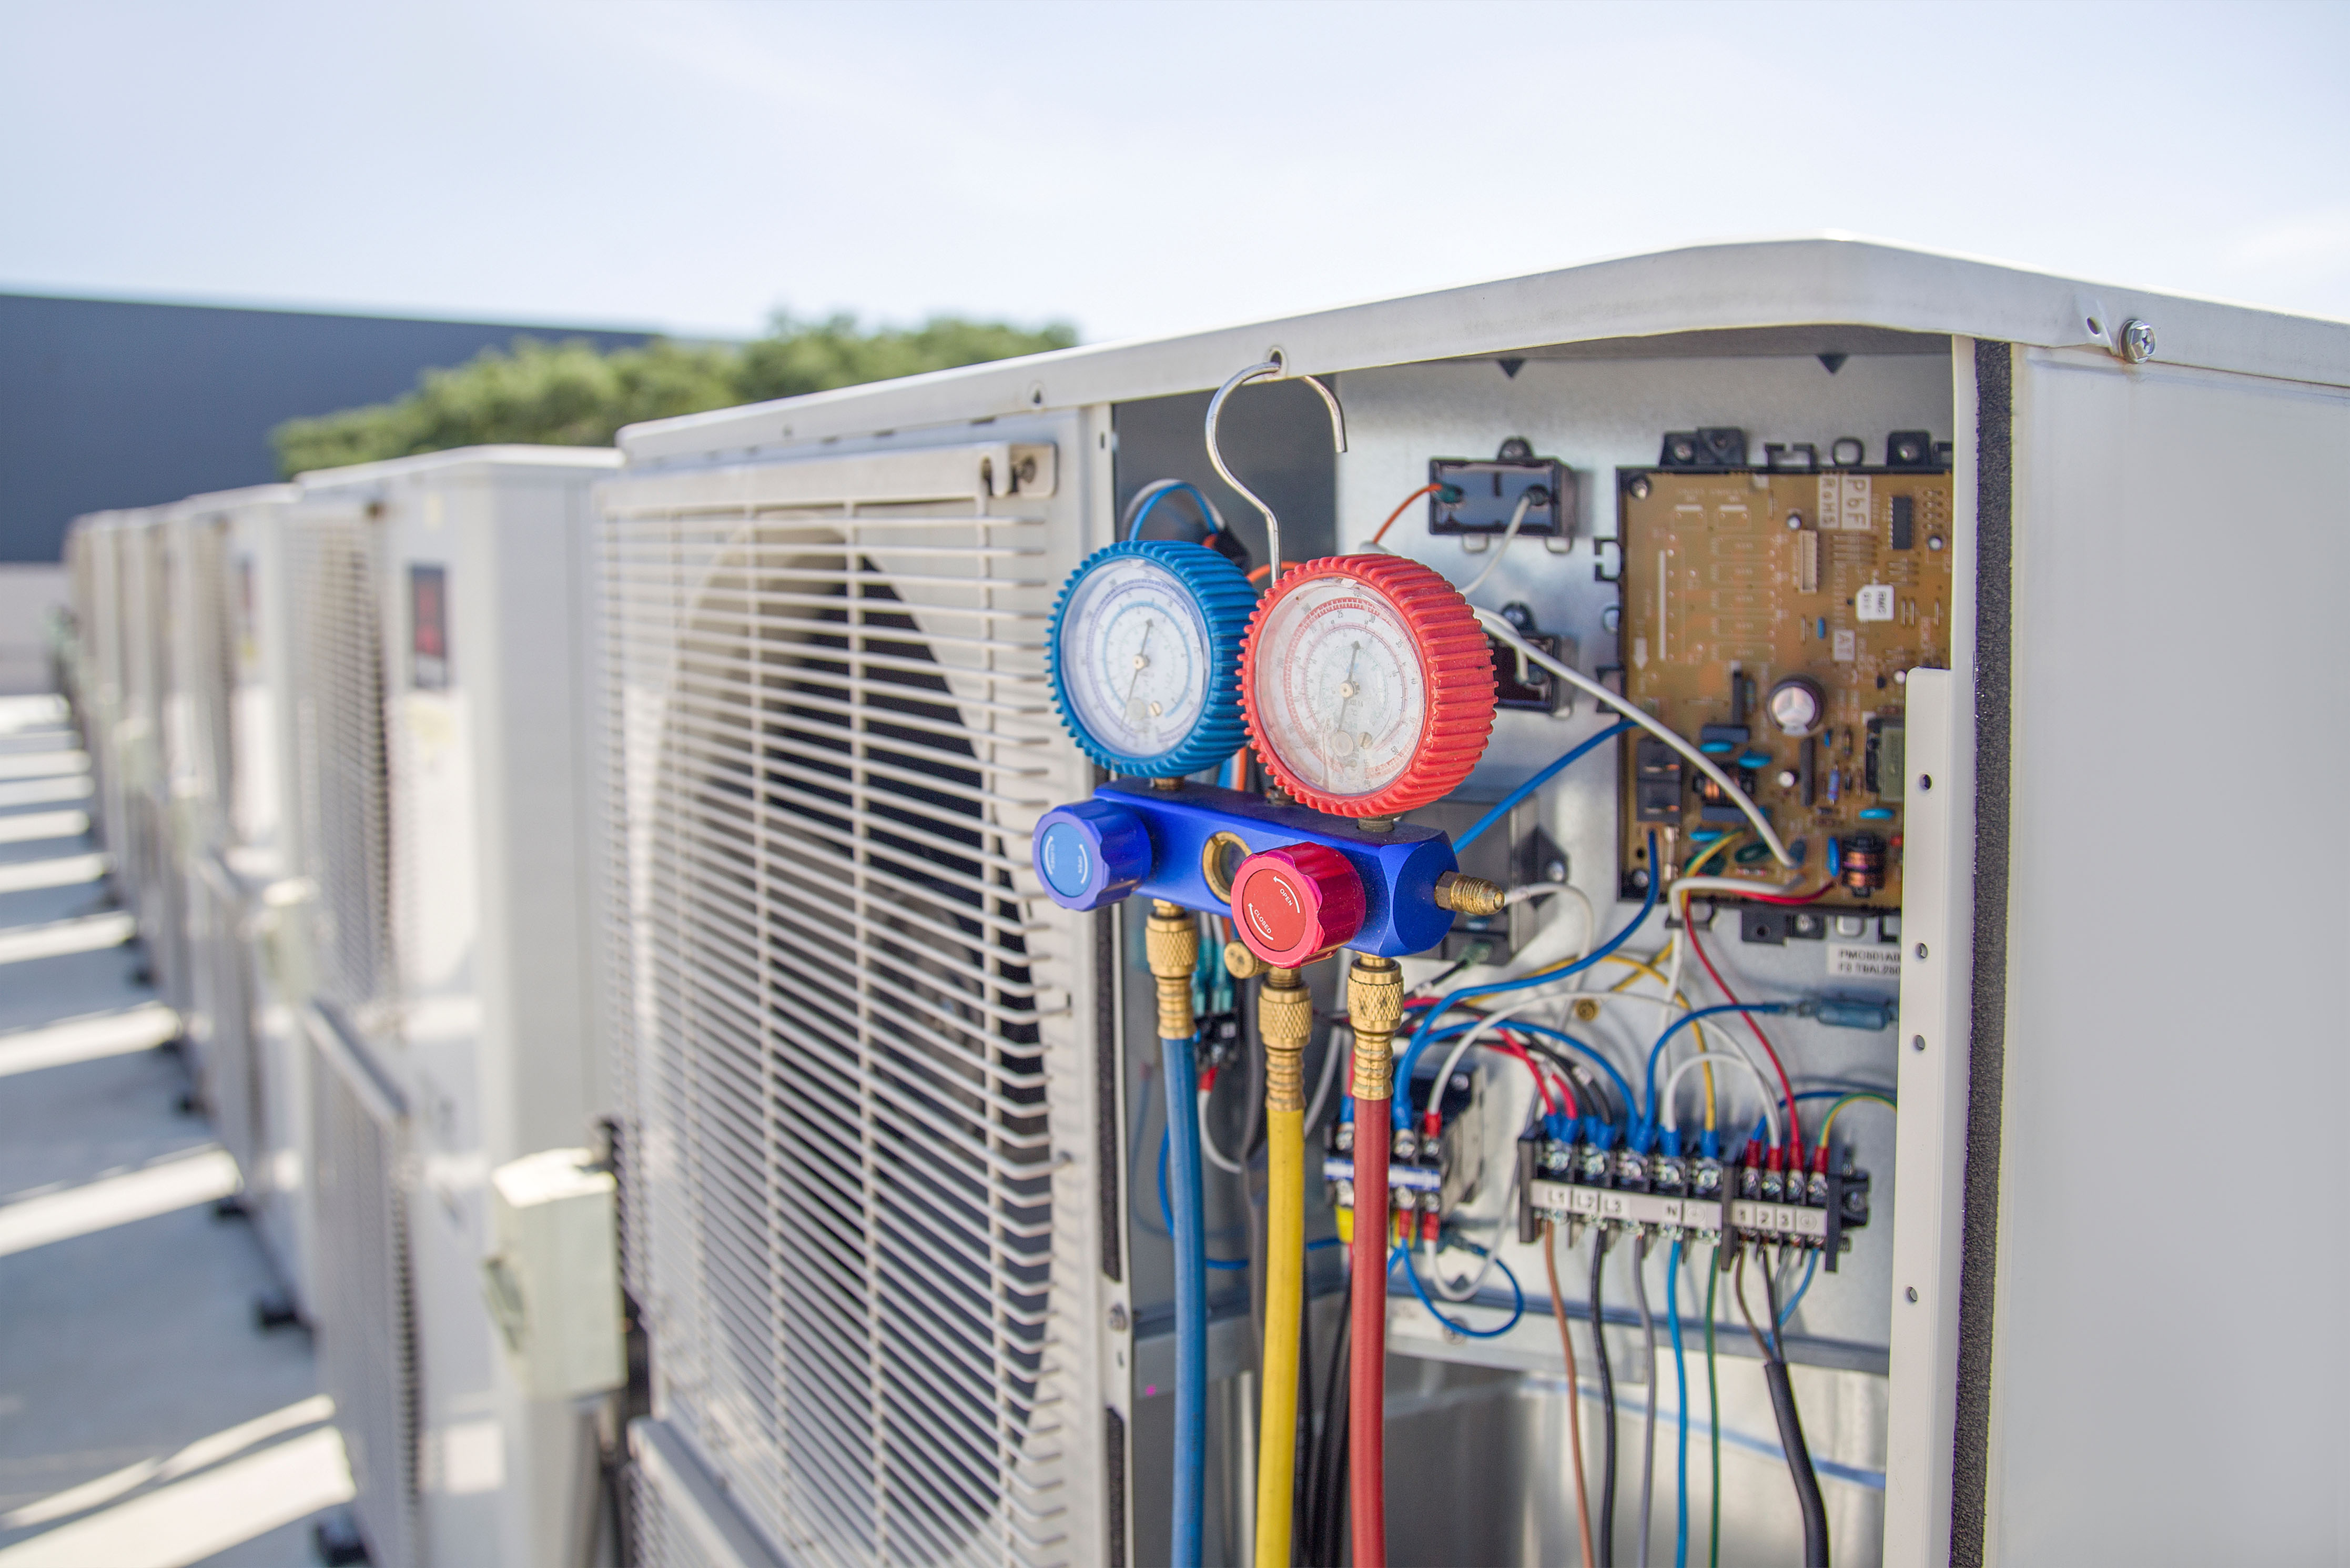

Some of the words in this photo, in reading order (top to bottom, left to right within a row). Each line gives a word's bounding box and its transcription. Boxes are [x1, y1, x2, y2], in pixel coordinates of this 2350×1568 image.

[1337, 610, 1344, 618] 25
[1369, 614, 1376, 623] 30
[1396, 639, 1403, 648] 35
[1391, 745, 1399, 755] 50
[1280, 888, 1293, 906] OPEN
[1254, 909, 1272, 934] CLOSED
[1548, 1190, 1565, 1204] L1
[1577, 1193, 1594, 1208] L2
[1604, 1198, 1622, 1213] L3
[1666, 1205, 1677, 1217] N
[1739, 1209, 1746, 1221] 1
[1760, 1211, 1769, 1225] 2
[1781, 1214, 1789, 1227] 3
